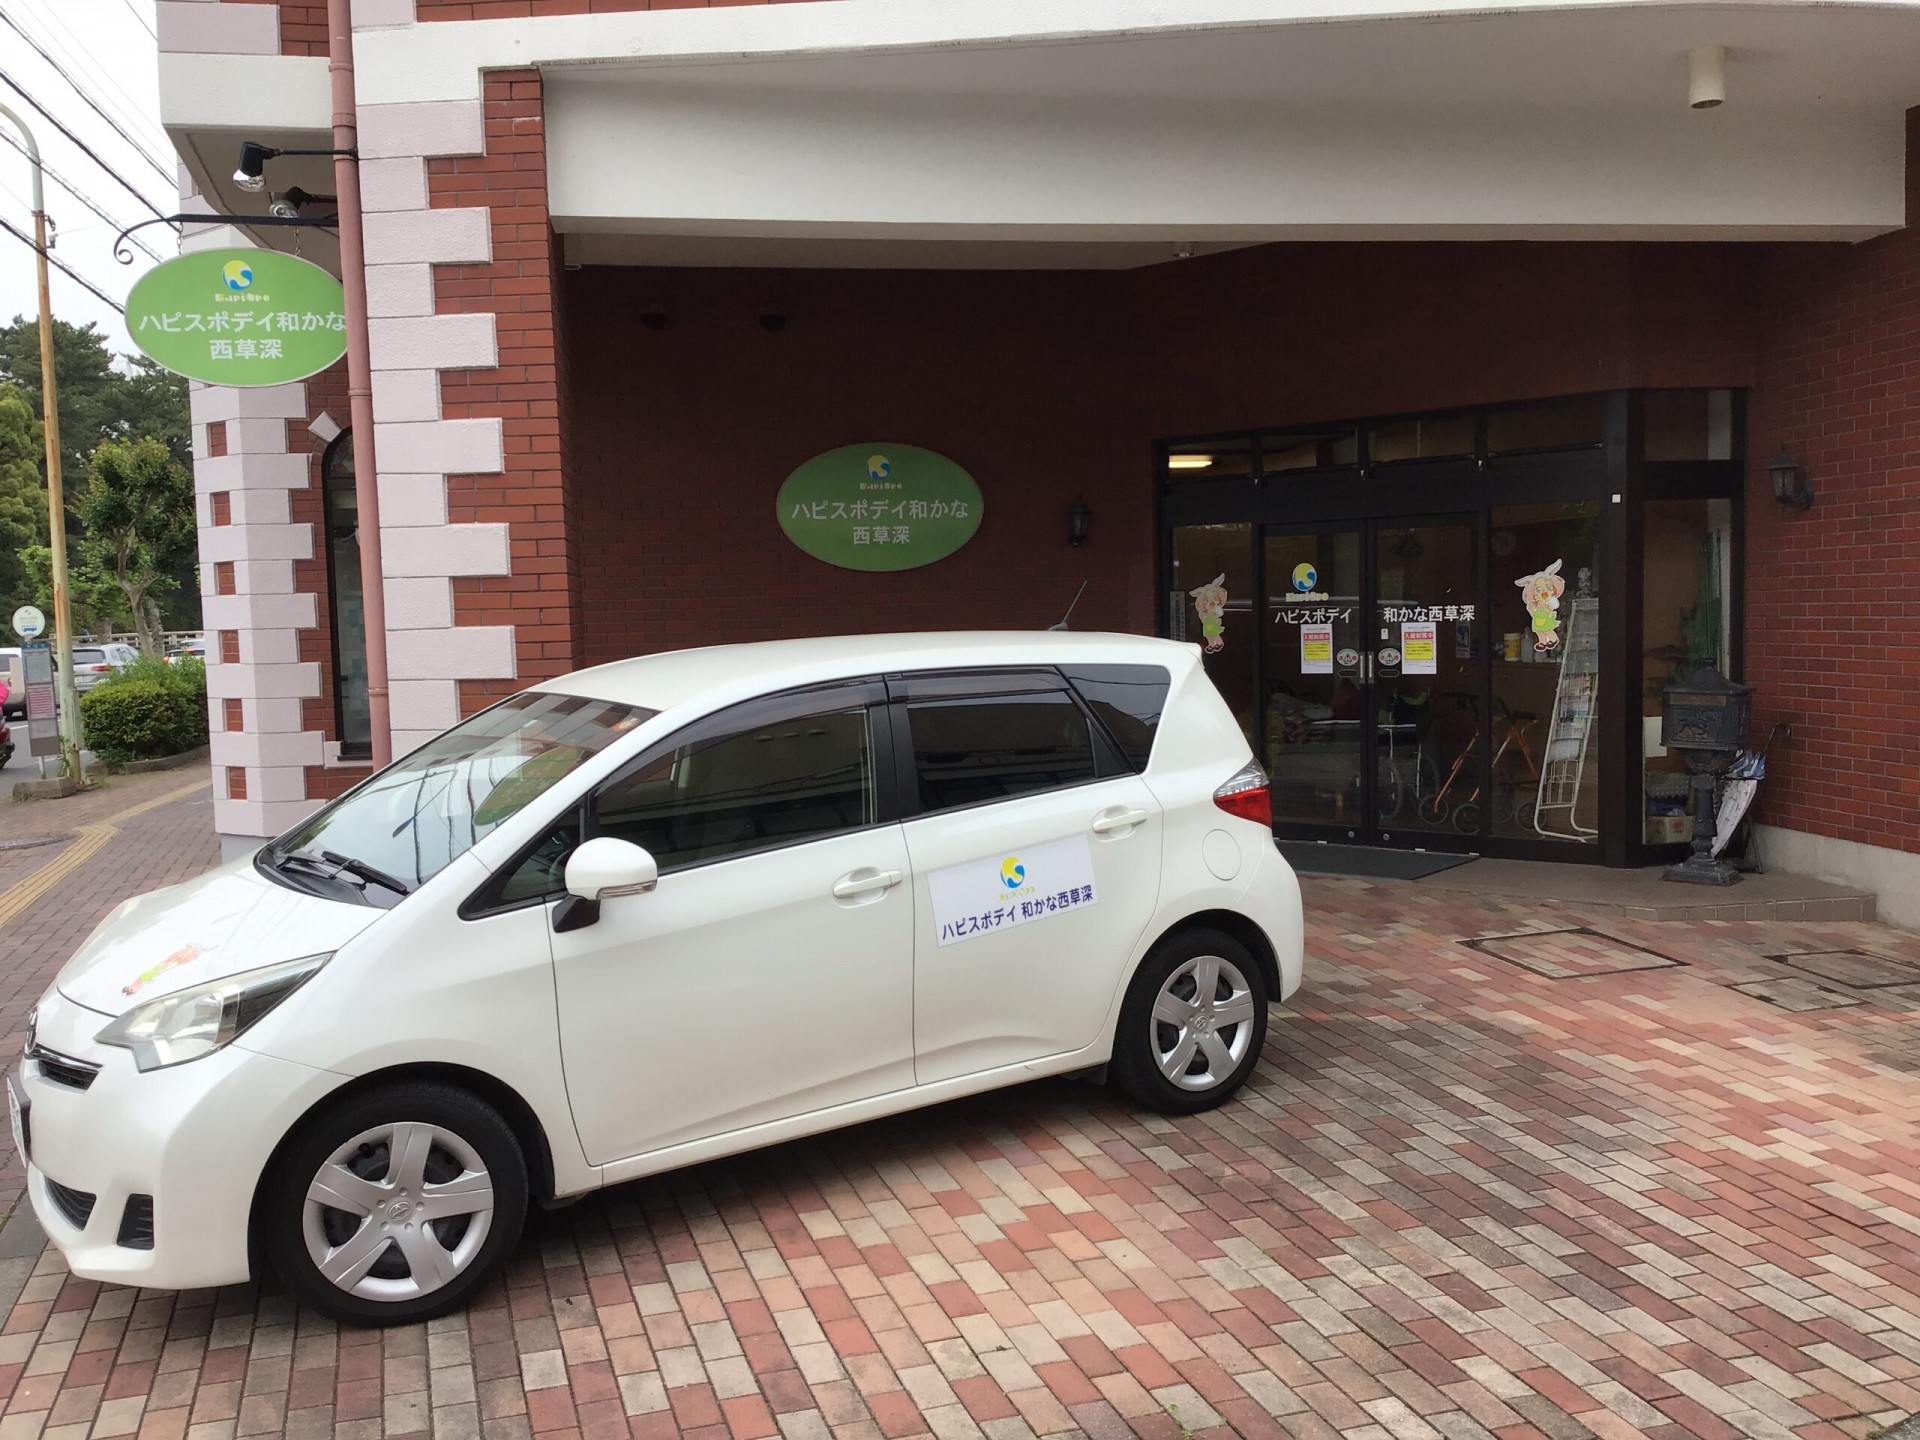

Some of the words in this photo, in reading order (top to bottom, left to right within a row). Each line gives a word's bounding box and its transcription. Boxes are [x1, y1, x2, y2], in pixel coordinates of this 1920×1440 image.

[139, 311, 347, 332] ハピスポデイ和かな
[209, 339, 284, 360] 西草深
[792, 498, 969, 520] ハピスポデイ和かな
[853, 525, 910, 545] 西草深
[1274, 608, 1352, 624] ハピスポデイ
[1383, 604, 1476, 623] 和かな西草深
[1021, 884, 1094, 920] 和かな西草深
